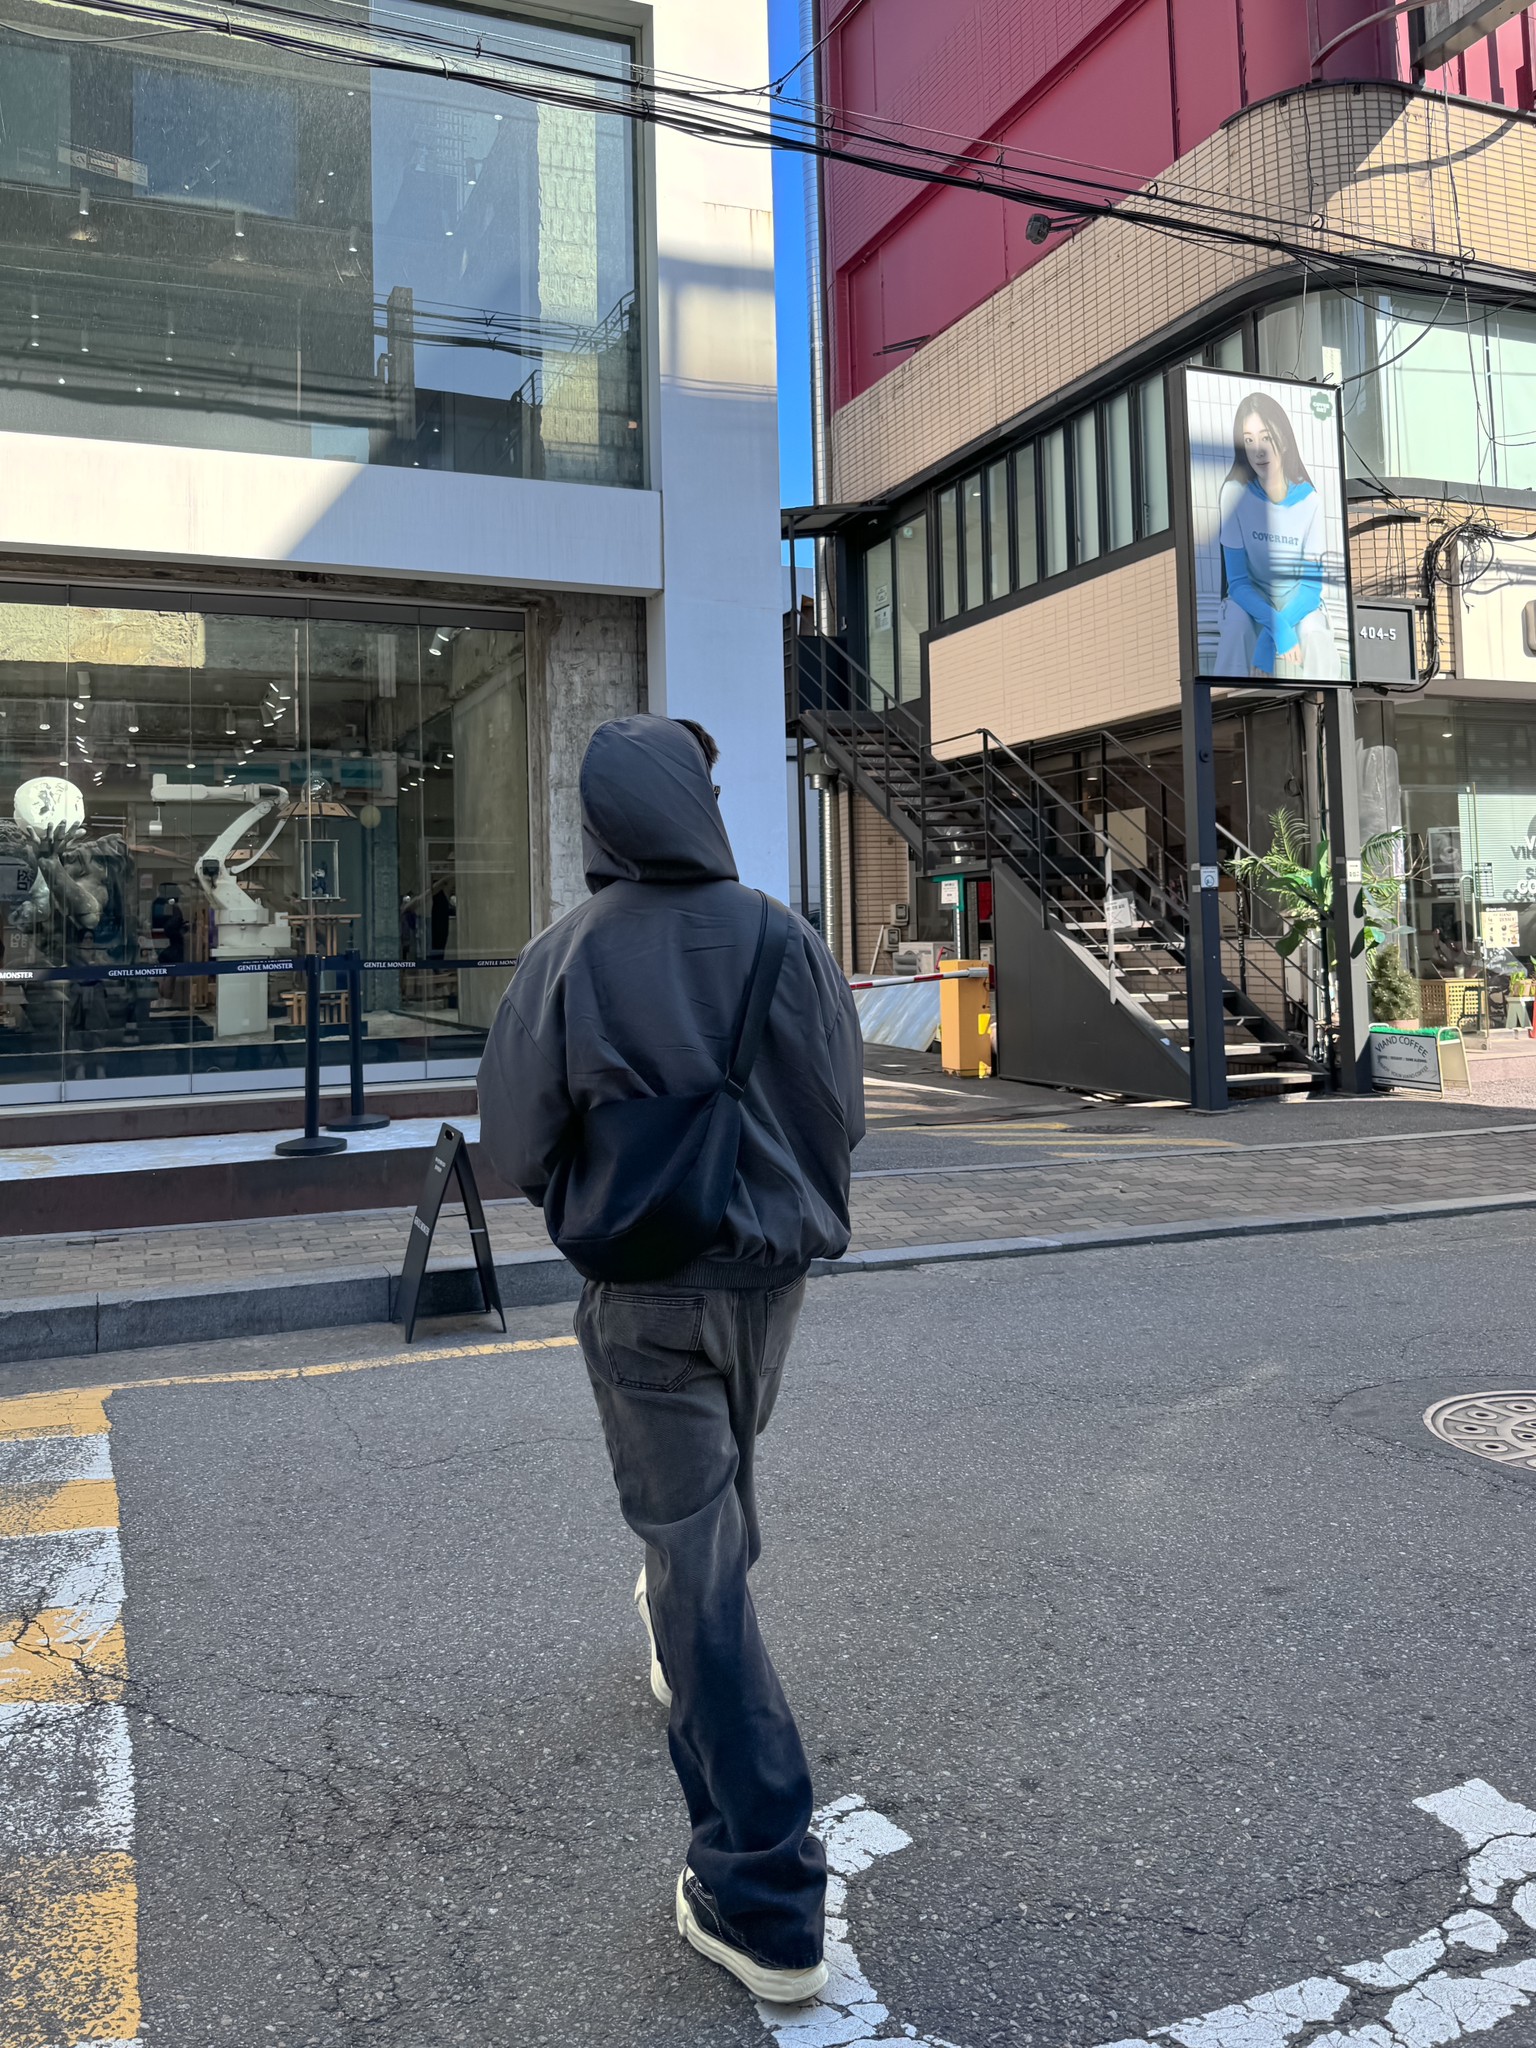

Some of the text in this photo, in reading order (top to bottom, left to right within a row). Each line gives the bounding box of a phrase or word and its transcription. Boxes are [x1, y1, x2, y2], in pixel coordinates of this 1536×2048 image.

[1360, 626, 1397, 641] 404-5
[262, 962, 293, 970] MONSTER
[135, 968, 168, 976] MONSTER
[1375, 1036, 1429, 1058] VIAND COFFEE
